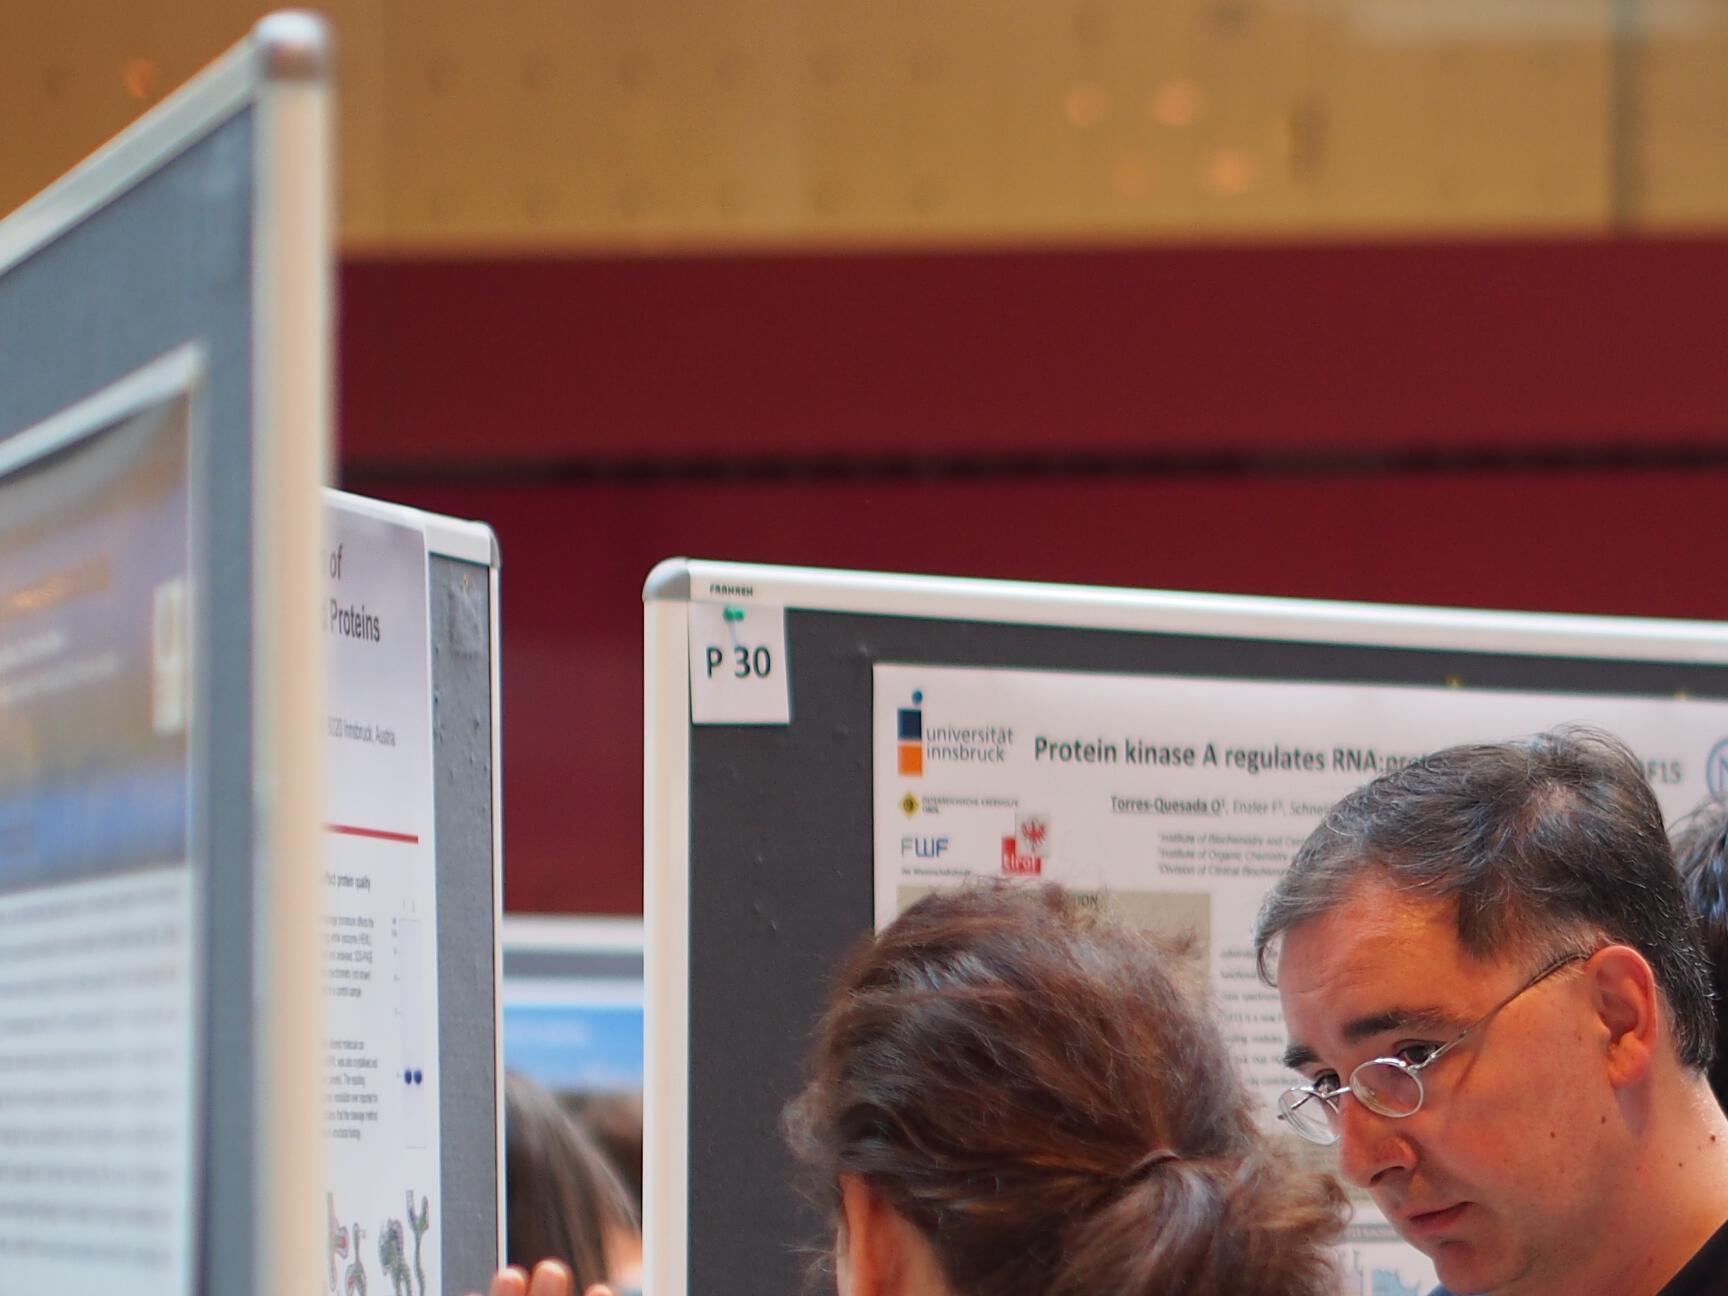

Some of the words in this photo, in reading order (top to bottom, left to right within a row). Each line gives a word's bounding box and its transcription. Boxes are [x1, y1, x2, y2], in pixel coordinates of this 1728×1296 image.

[329, 598, 381, 643] Proteins
[706, 646, 723, 678] P
[734, 645, 772, 679] 30
[925, 726, 1013, 746] universität
[926, 744, 1005, 763] innsbruck
[1034, 735, 1117, 764] Protein
[1124, 740, 1195, 768] kinase
[1202, 743, 1218, 768] A
[1225, 745, 1325, 775] regulates
[1110, 796, 1207, 816] Torres-Quesada
[901, 838, 949, 858] FWF
